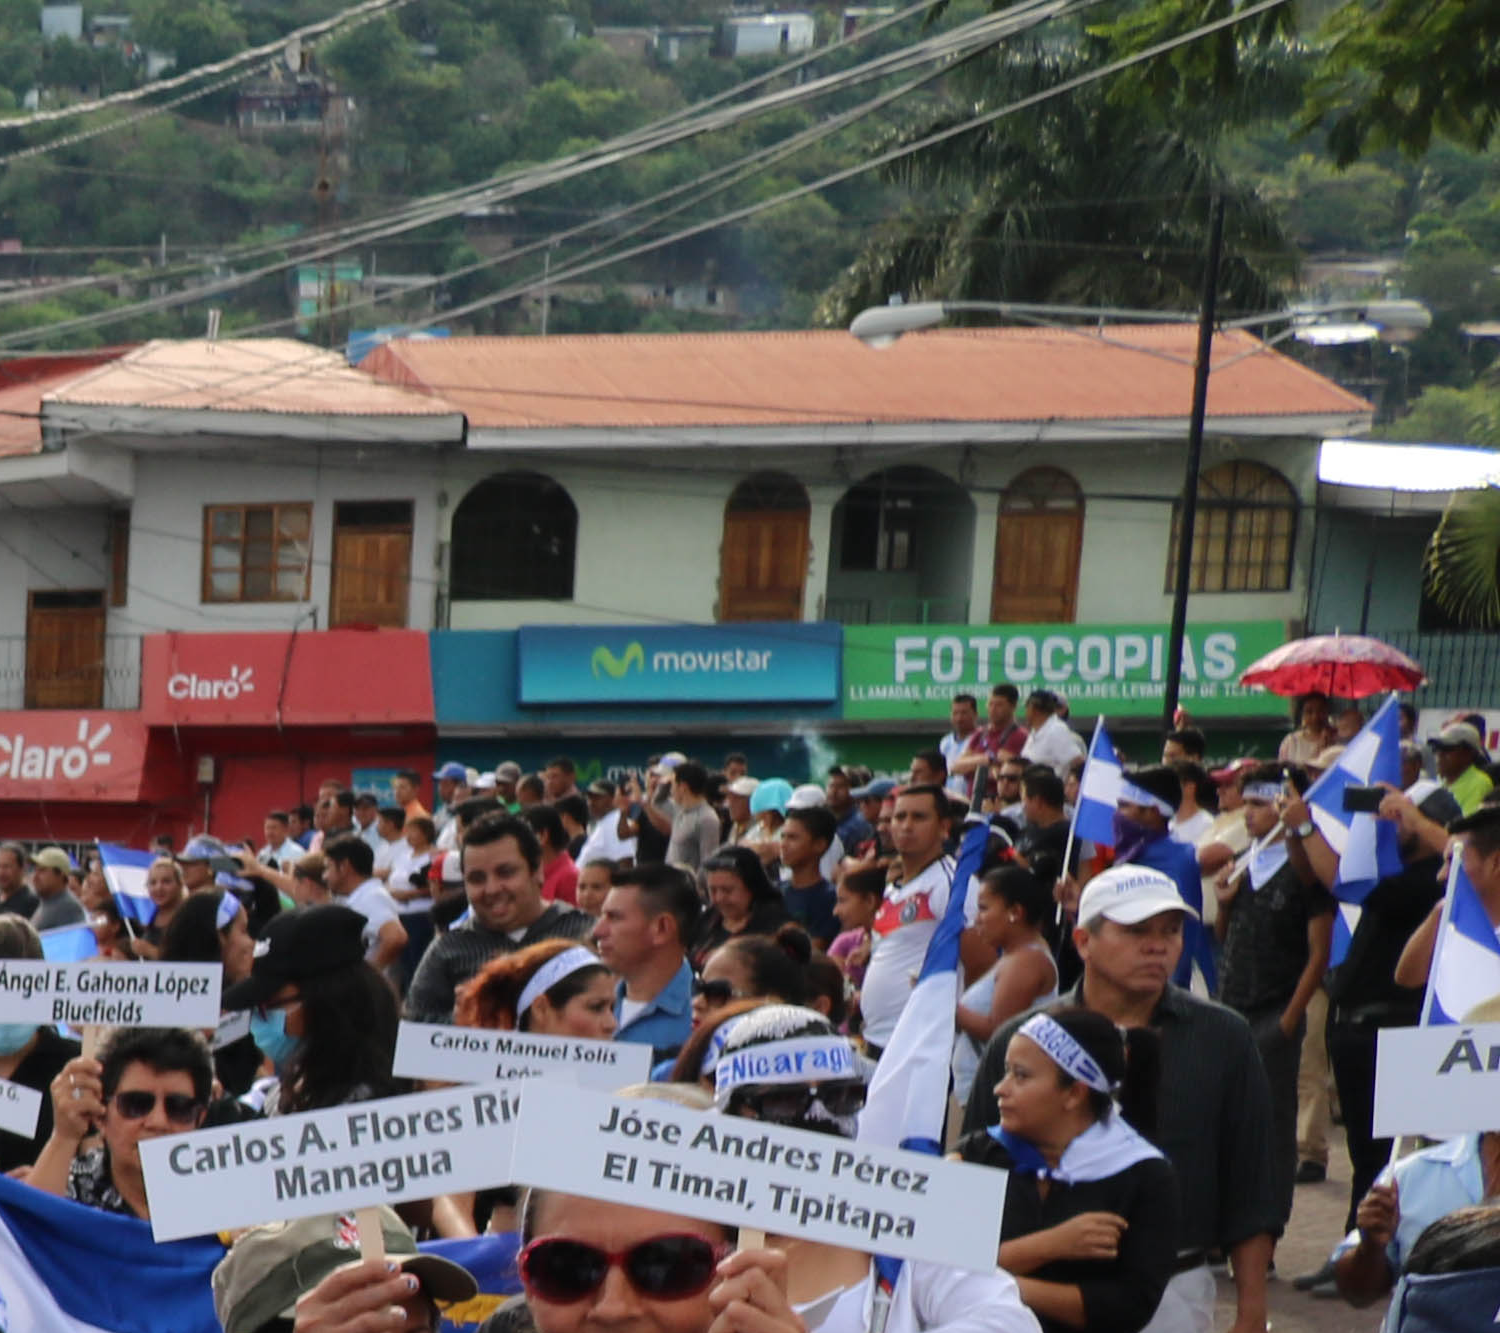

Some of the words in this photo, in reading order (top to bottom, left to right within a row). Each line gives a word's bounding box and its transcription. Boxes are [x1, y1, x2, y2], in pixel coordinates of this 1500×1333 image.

[651, 646, 772, 675] movistar
[167, 668, 238, 702] Claro
[52, 971, 73, 996] E.
[76, 969, 150, 997] Gahona
[154, 968, 211, 1001] López
[51, 997, 144, 1025] Bluefields
[429, 1030, 490, 1053] Carlos
[495, 1036, 569, 1060] Manuel
[167, 1133, 287, 1176] Carlos
[298, 1119, 340, 1156] A.
[348, 1106, 464, 1146] Flores
[598, 1105, 685, 1151] Jóse
[689, 1122, 823, 1176] Andres
[833, 1150, 931, 1198] Pérez
[273, 1146, 455, 1204] Managua
[603, 1152, 639, 1182] El
[647, 1159, 757, 1212] Timal,
[767, 1183, 918, 1242] Tipitapa
